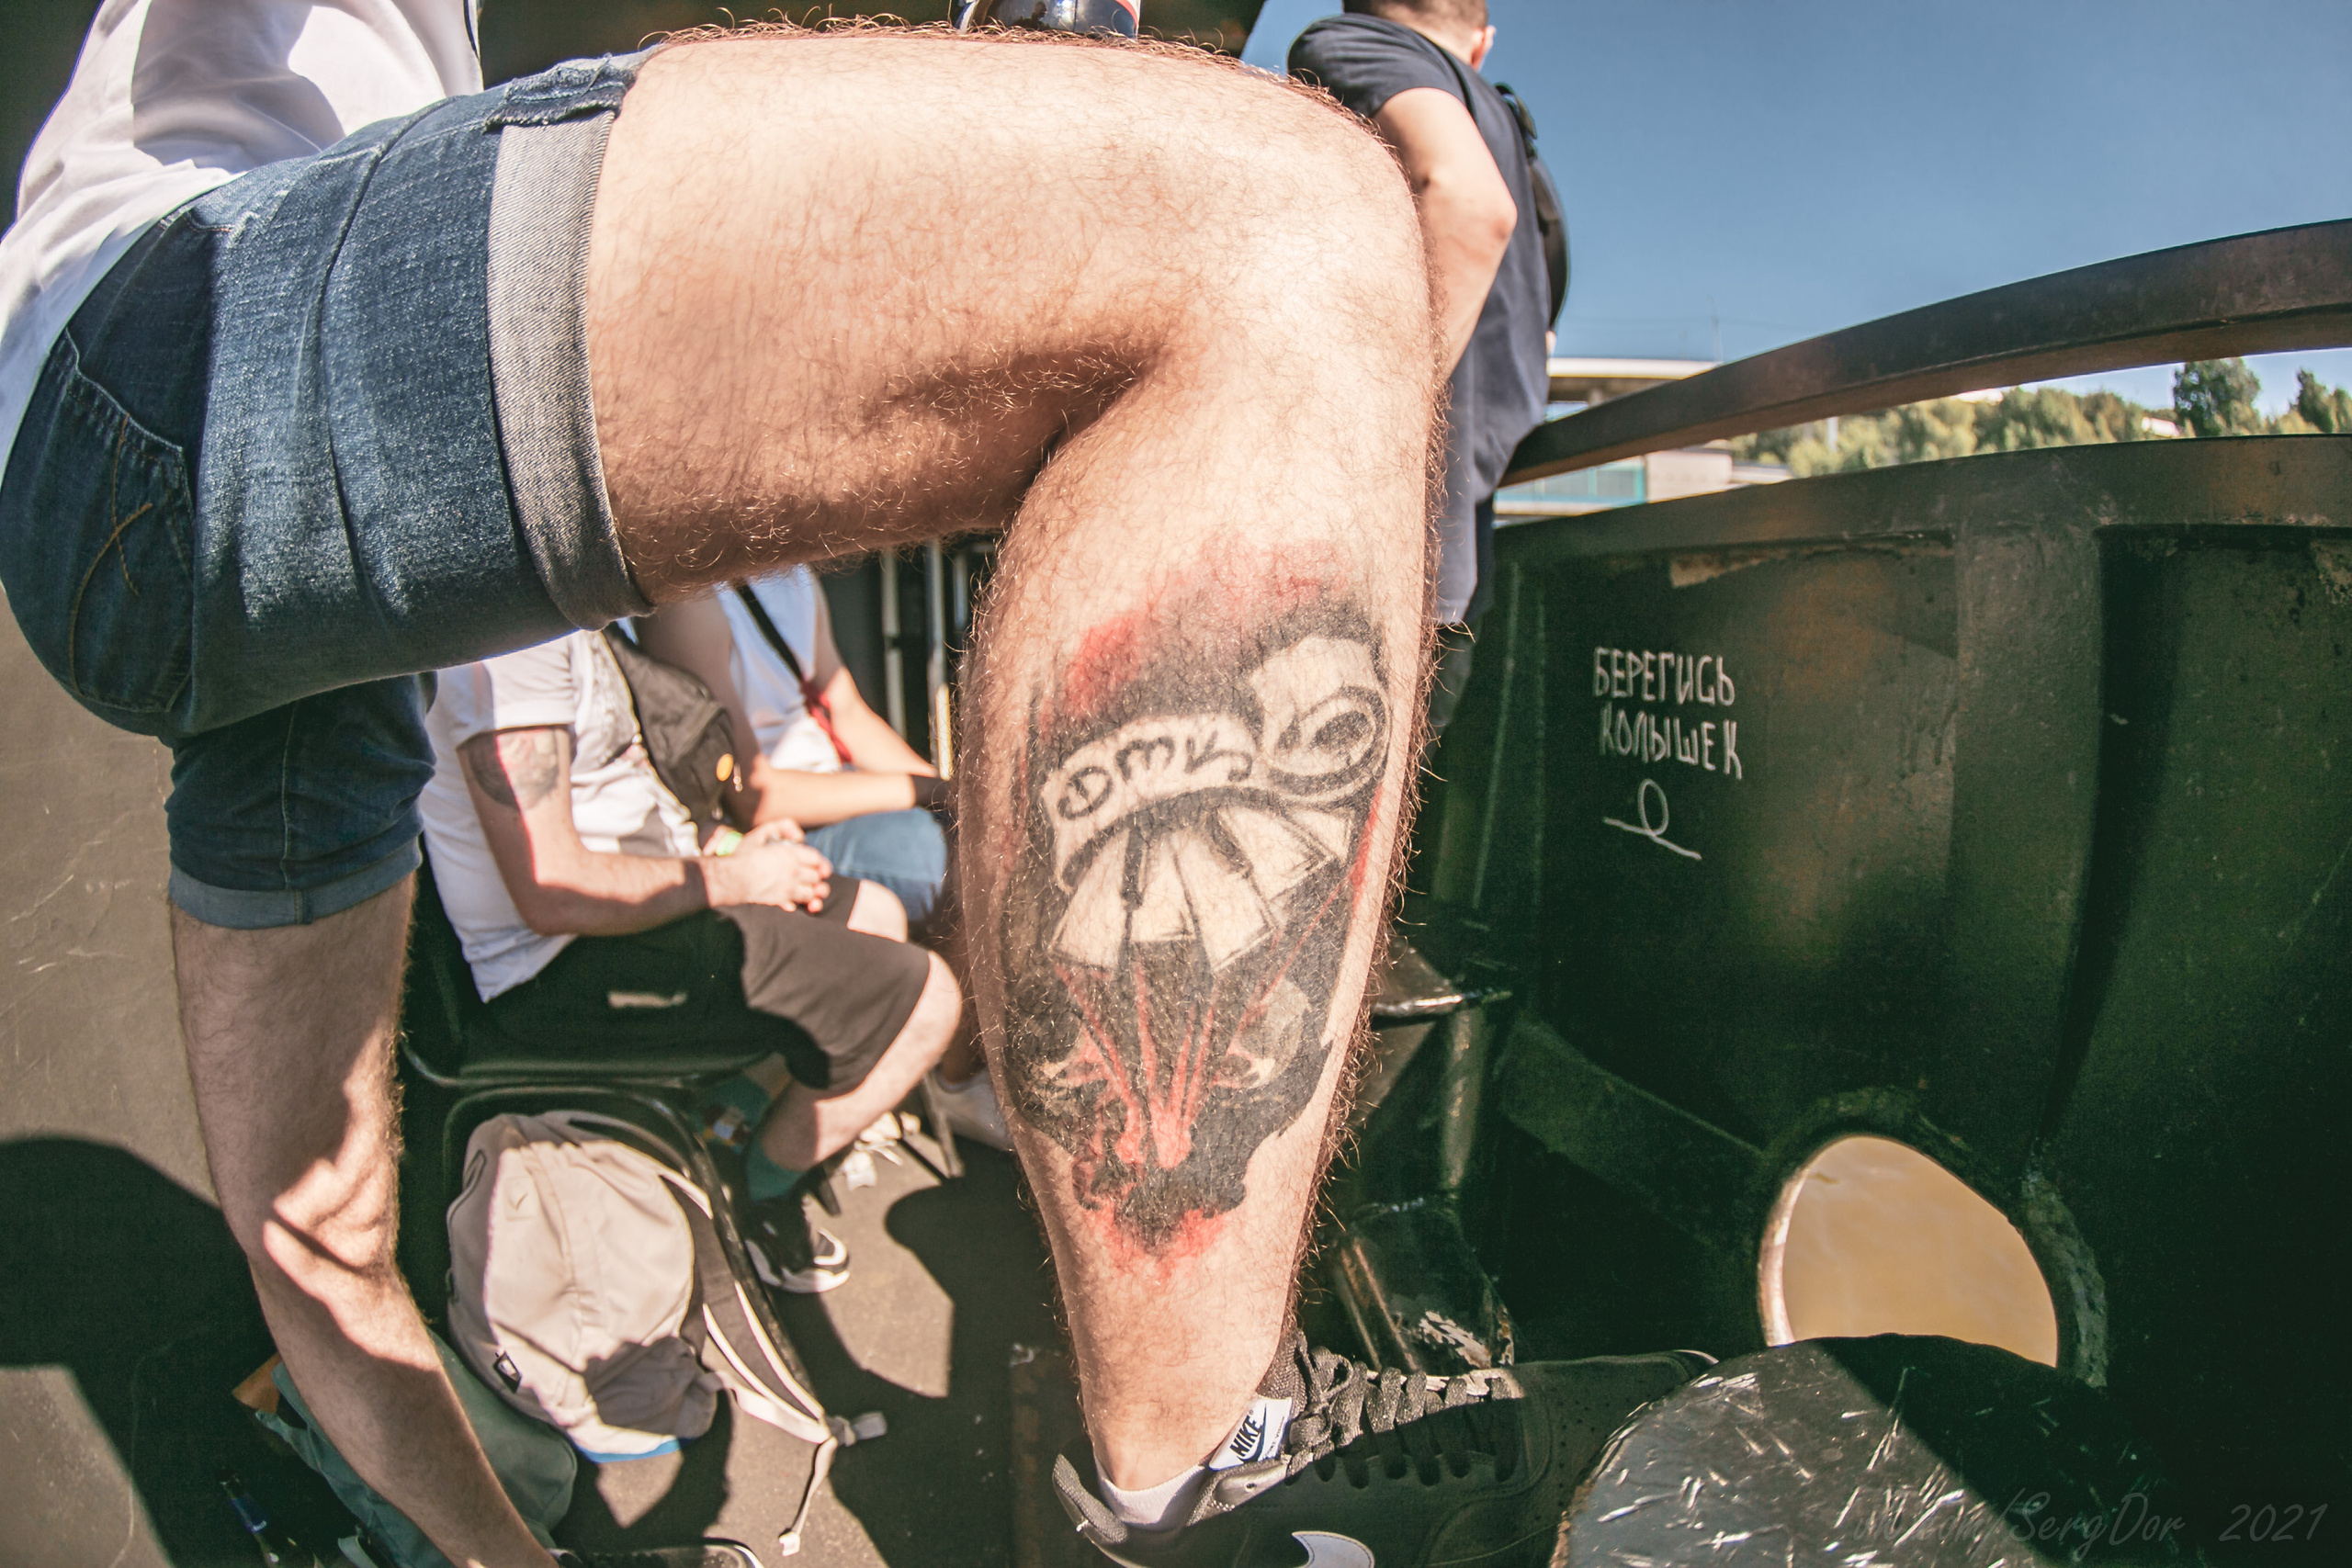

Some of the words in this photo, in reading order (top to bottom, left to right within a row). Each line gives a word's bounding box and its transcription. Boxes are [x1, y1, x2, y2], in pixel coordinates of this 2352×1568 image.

[1594, 647, 1735, 706] БЕРЕГИСЬ
[1600, 701, 1742, 780] КОЛЫШЕК
[1230, 1415, 1262, 1457] NIKE
